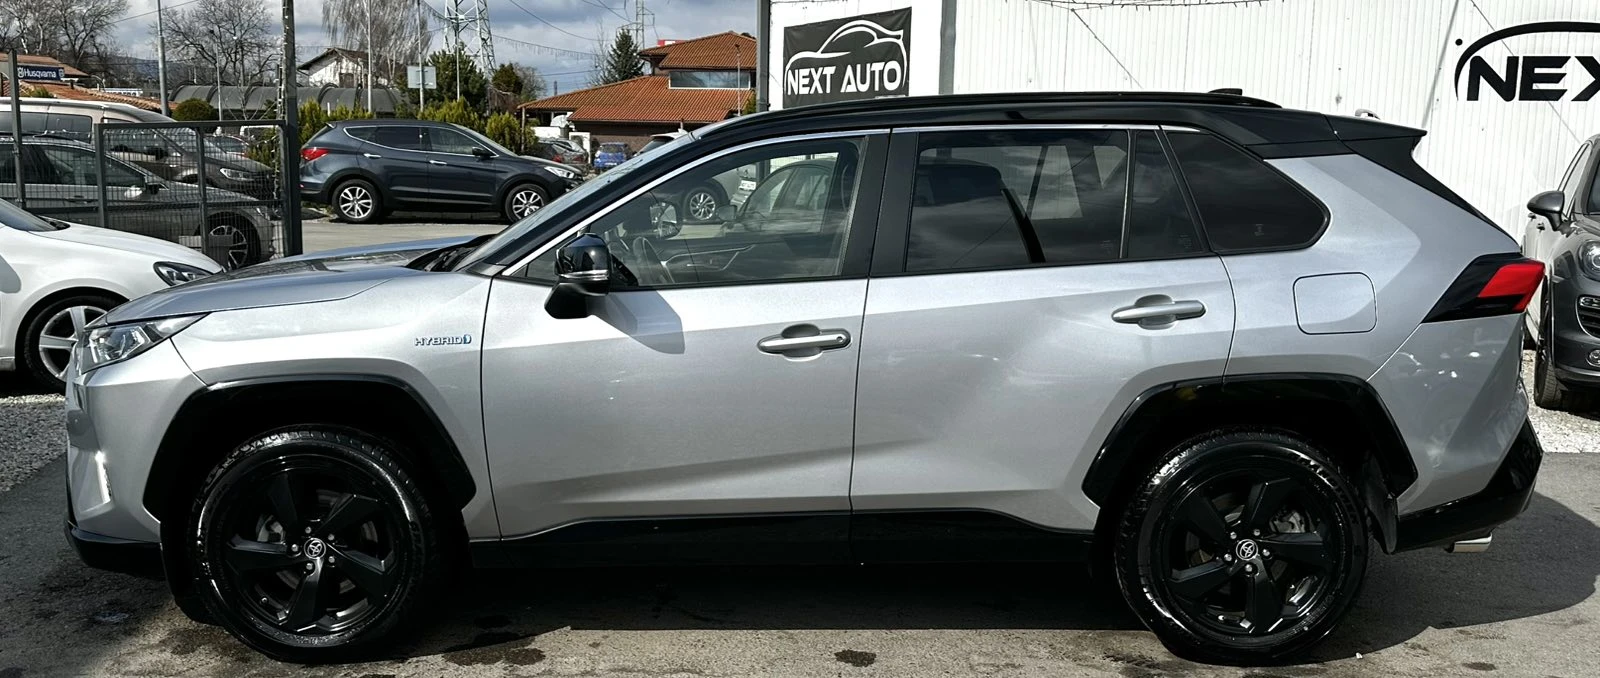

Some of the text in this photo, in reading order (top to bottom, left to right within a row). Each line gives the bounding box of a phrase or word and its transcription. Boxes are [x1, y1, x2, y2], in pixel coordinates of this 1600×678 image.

[24, 68, 57, 78] Husqvarna
[787, 60, 902, 95] NEXT AUTO
[415, 336, 463, 346] HYBRID
